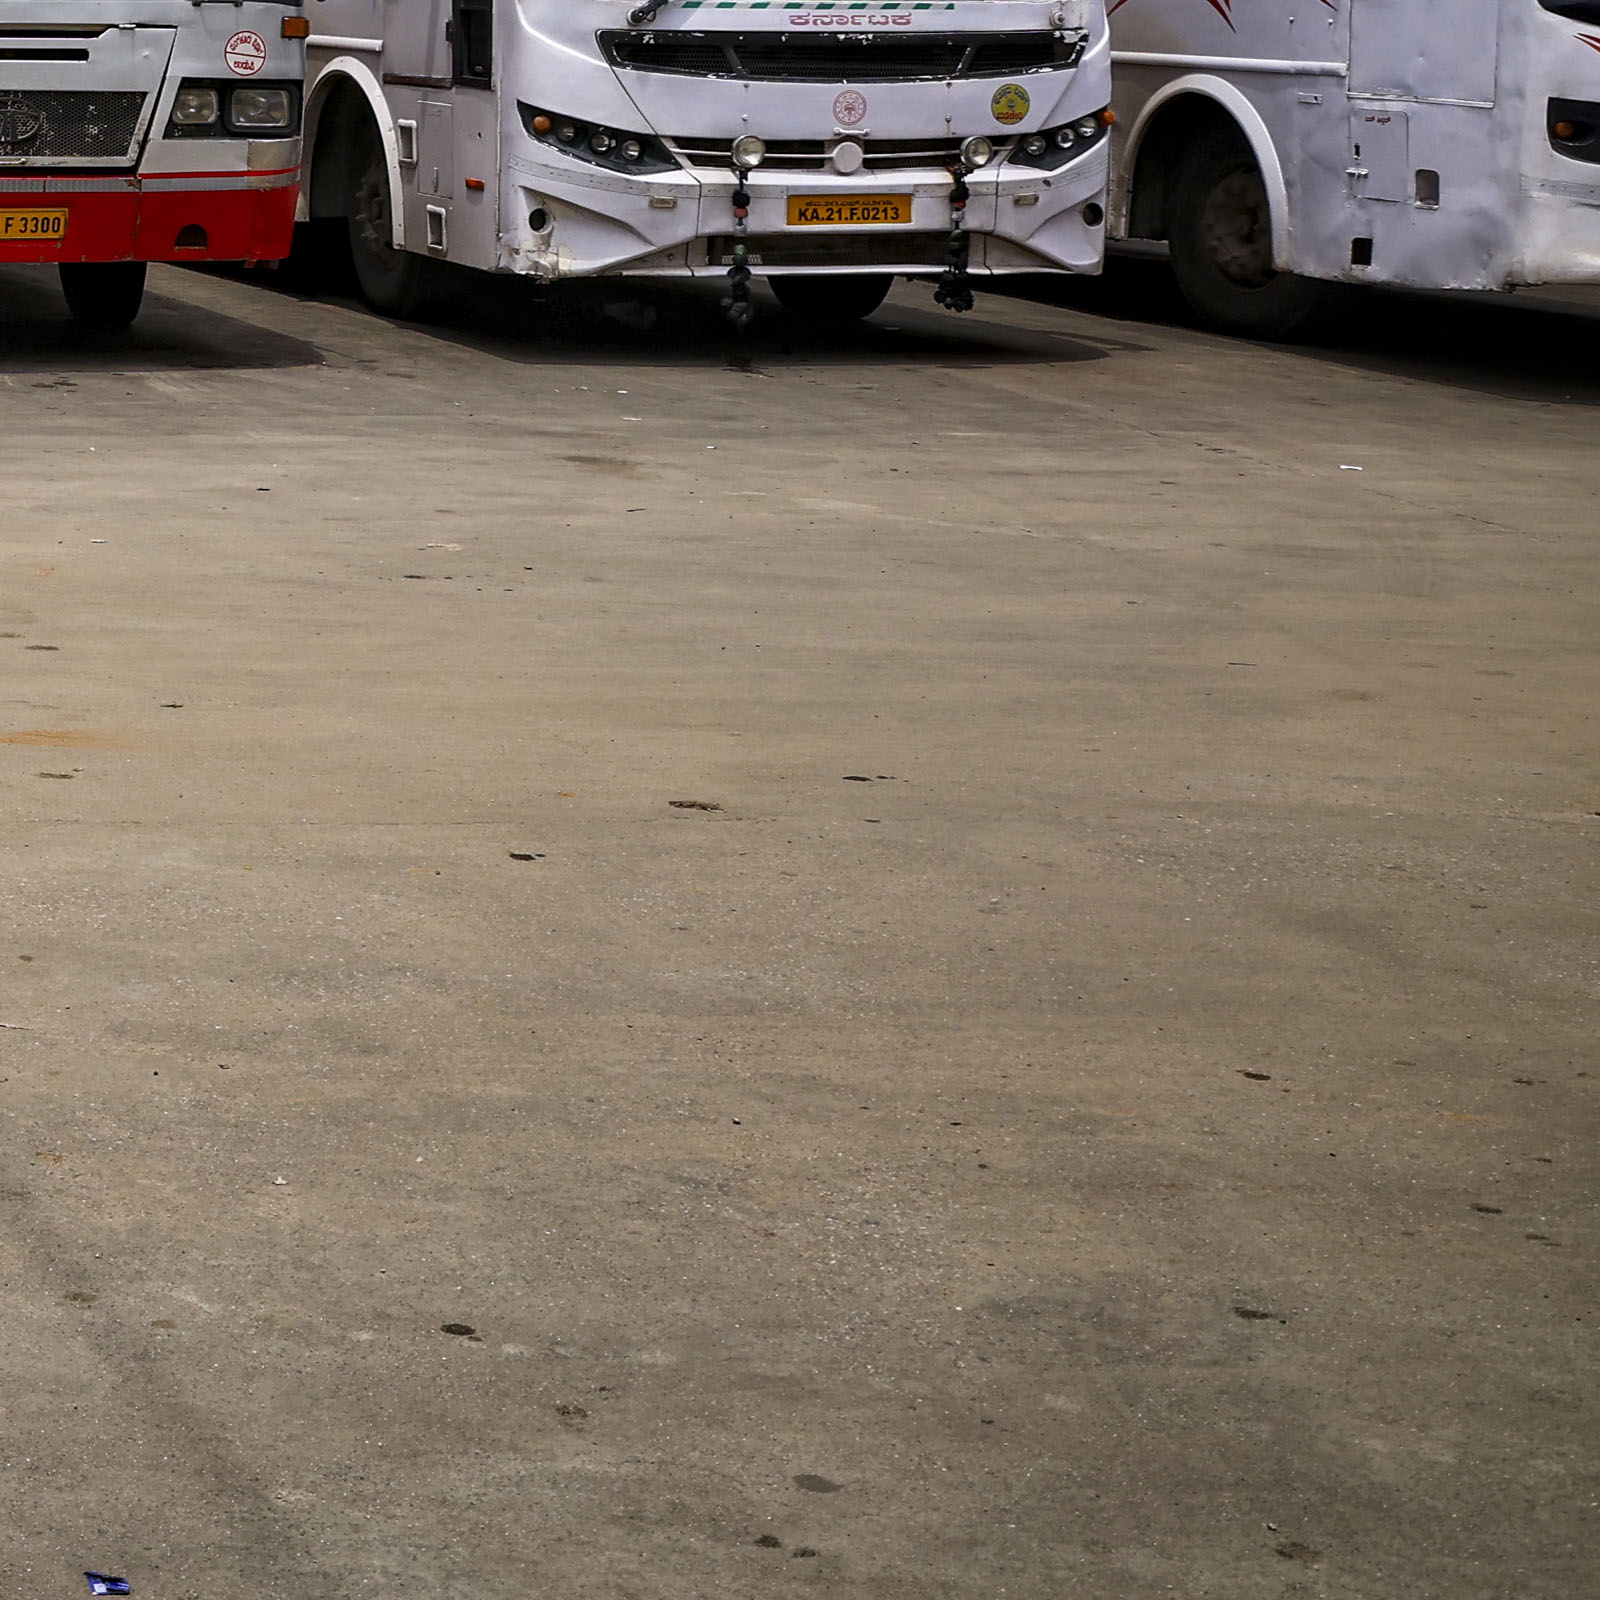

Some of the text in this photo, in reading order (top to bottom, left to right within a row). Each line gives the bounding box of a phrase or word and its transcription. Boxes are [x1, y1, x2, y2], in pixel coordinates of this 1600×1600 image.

[788, 12, 912, 26] ಕರ್ನಾಟಕ
[798, 207, 899, 221] KA.21.F.0213
[19, 217, 61, 233] 3300
